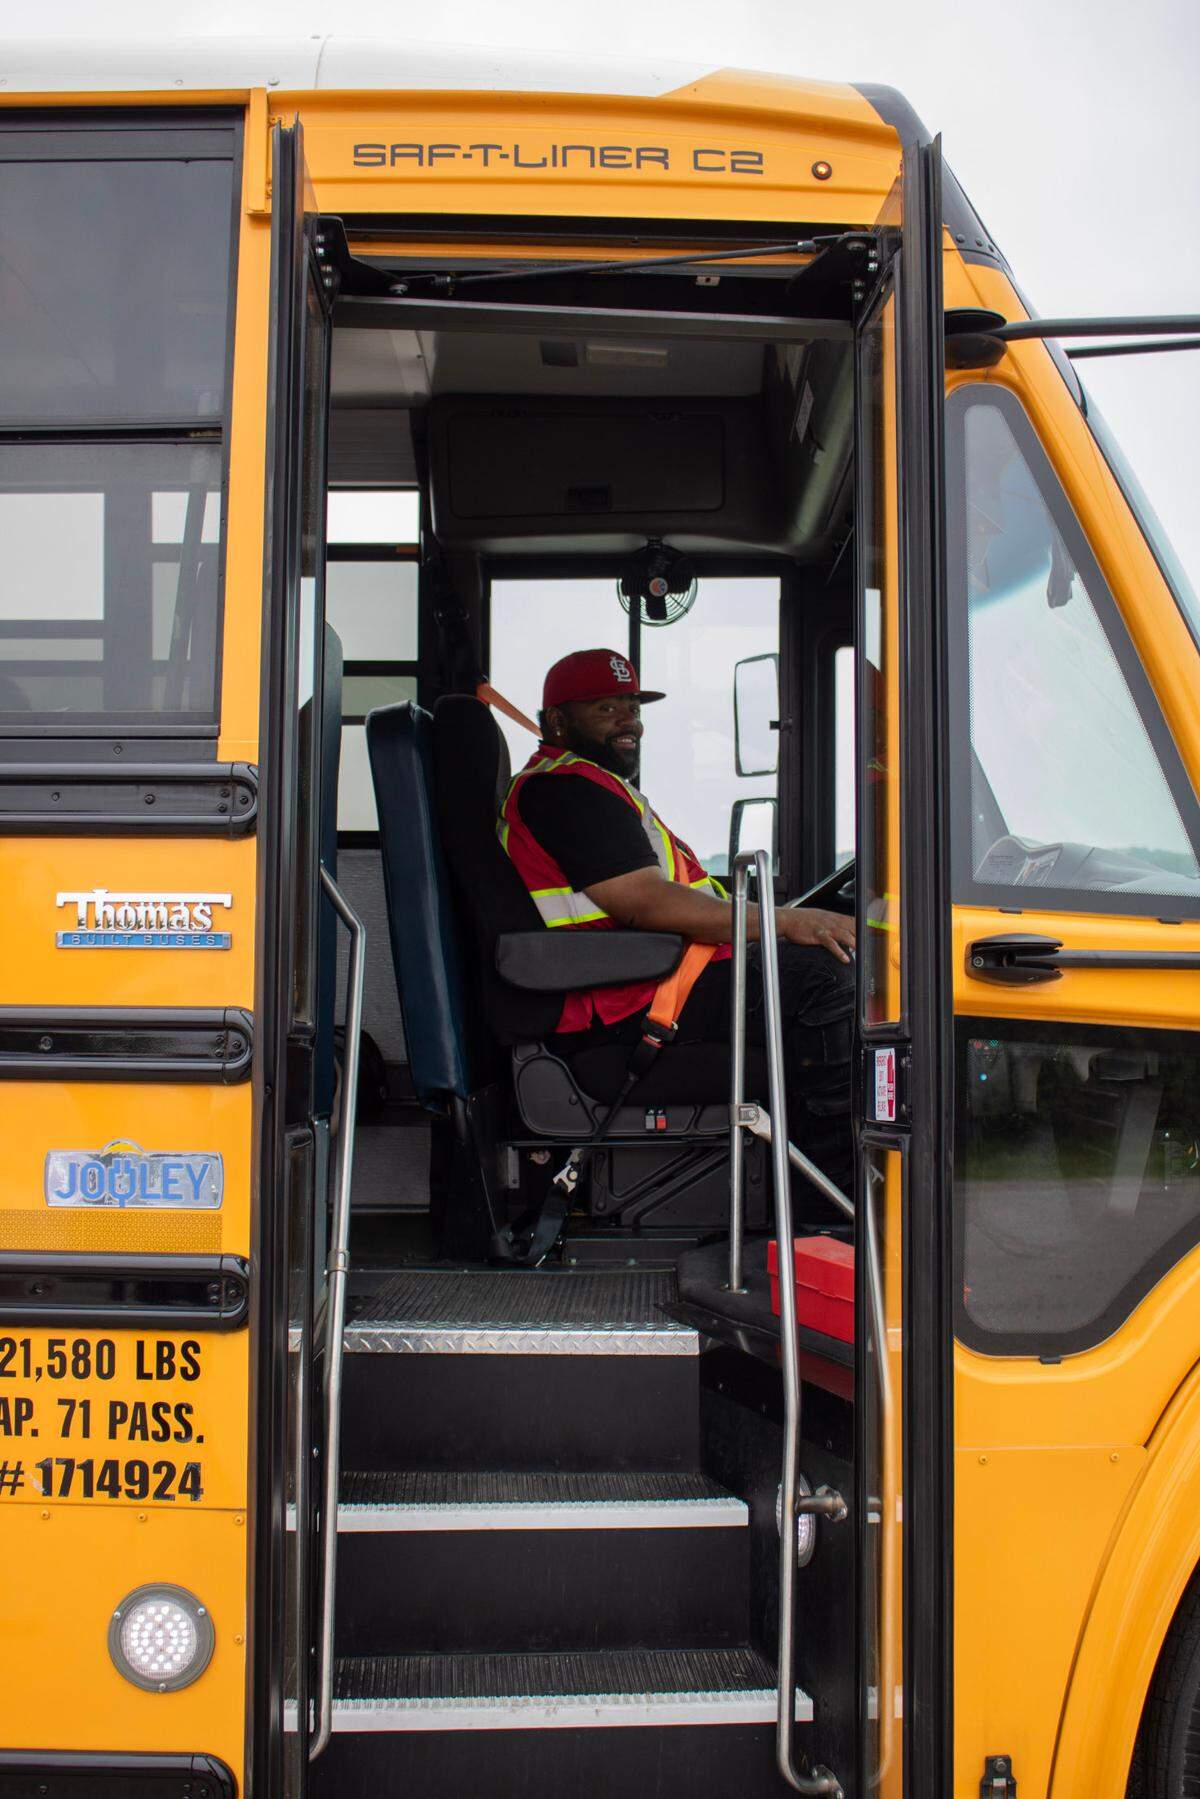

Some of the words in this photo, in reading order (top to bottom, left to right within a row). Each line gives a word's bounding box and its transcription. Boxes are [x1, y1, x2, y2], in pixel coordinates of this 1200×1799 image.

[353, 143, 670, 170] SAF-T-LINER
[693, 149, 764, 175] C2
[56, 889, 232, 932] Thomas
[71, 935, 133, 945] BUILT
[143, 935, 215, 945] BUSES
[0, 1337, 116, 1382] 21,580
[136, 1340, 202, 1381] LBS
[57, 1398, 91, 1439] 71
[108, 1400, 205, 1444] PASS.
[35, 1457, 204, 1501] 1714924
